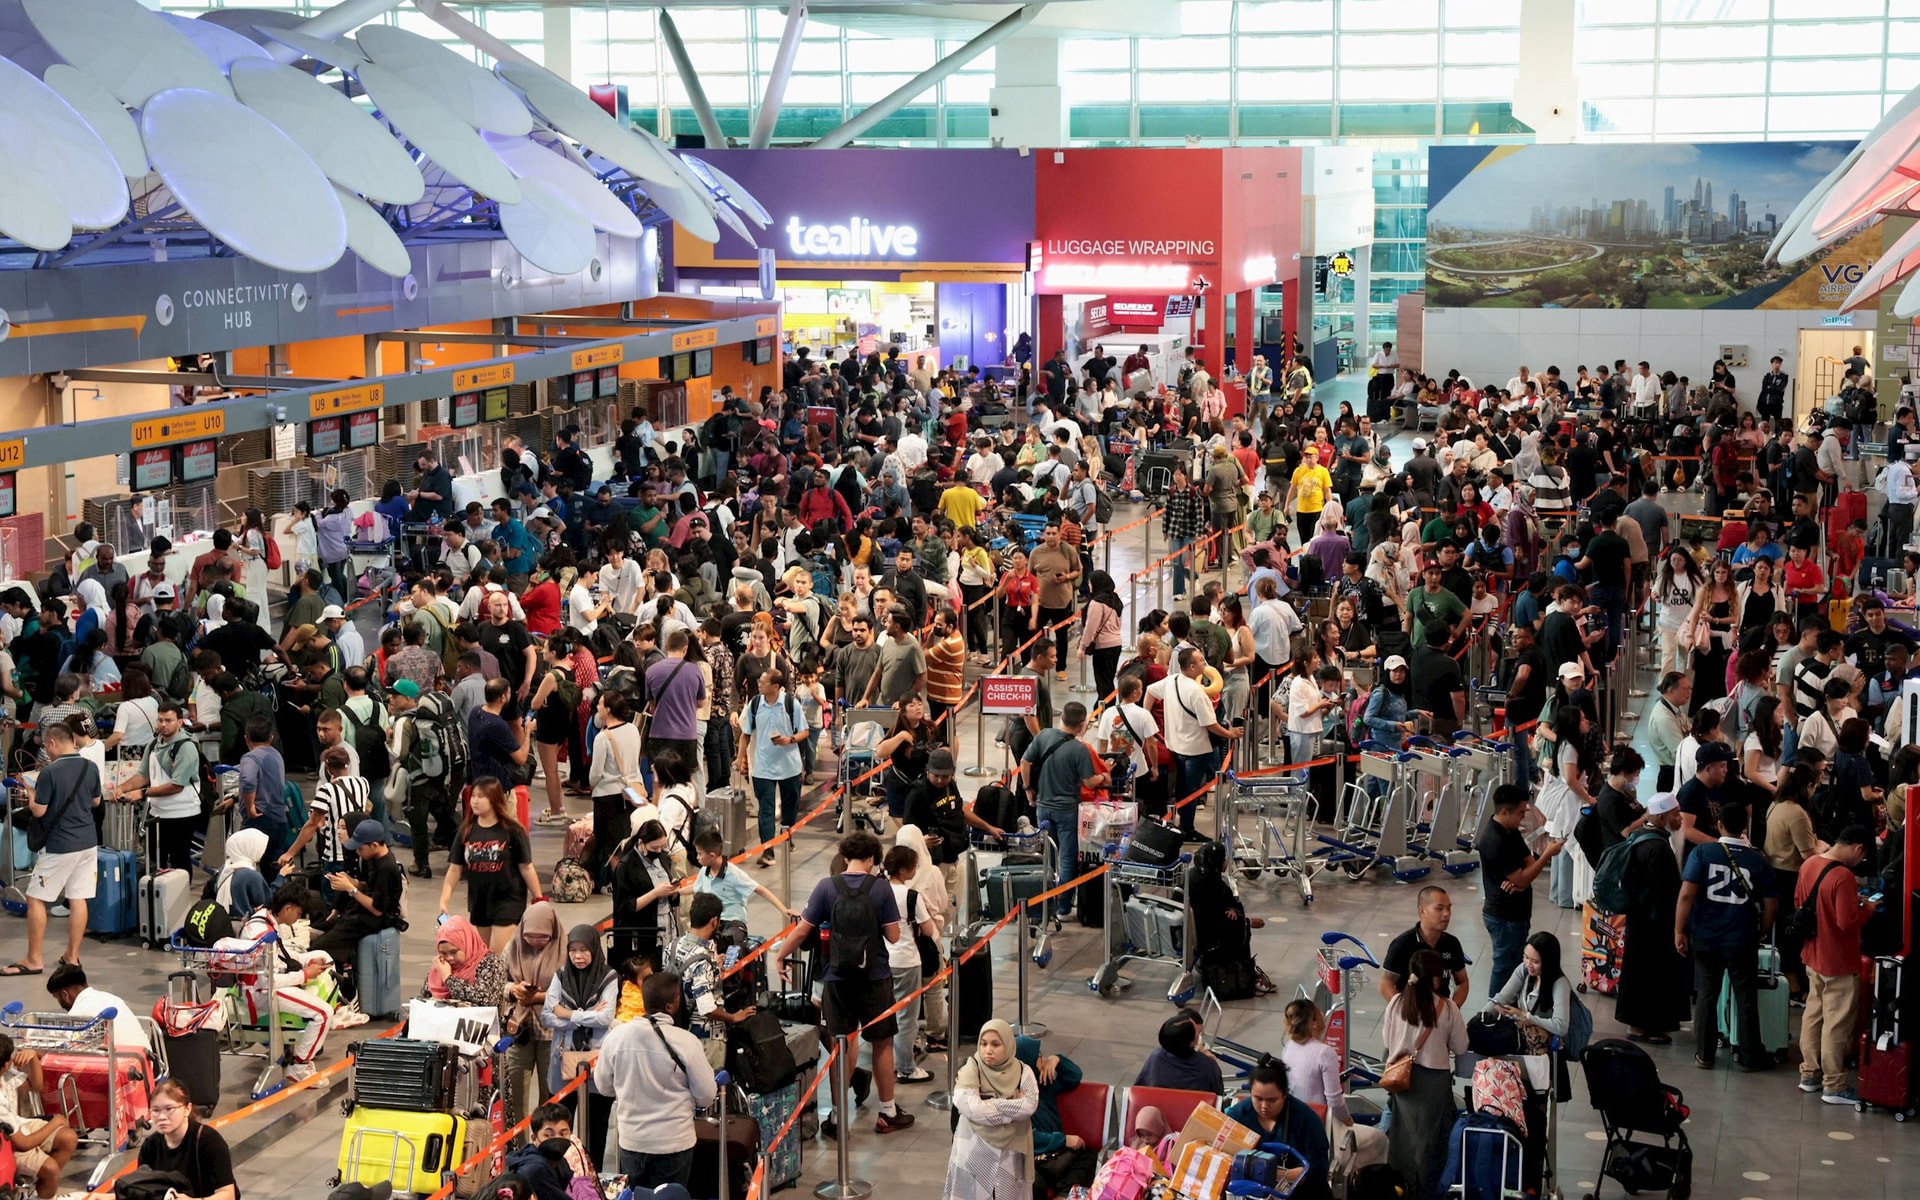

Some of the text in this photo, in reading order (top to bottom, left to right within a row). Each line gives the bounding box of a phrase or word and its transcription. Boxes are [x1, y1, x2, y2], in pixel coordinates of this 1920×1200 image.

[786, 216, 918, 256] tealive
[1048, 239, 1214, 255] LUGGAGE WRAPPING
[183, 283, 288, 308] CONNECTIVITY
[224, 311, 252, 329] HUB
[612, 348, 620, 359] U4
[457, 374, 465, 387] U7
[502, 367, 511, 379] U6
[369, 389, 379, 402] U8
[315, 398, 325, 412] U9
[204, 415, 221, 430] U10
[135, 425, 153, 441] U11
[0, 446, 19, 462] U12
[987, 684, 1032, 692] ASSISTED
[987, 692, 1032, 700] CHECK-IN
[1706, 863, 1754, 905] 23
